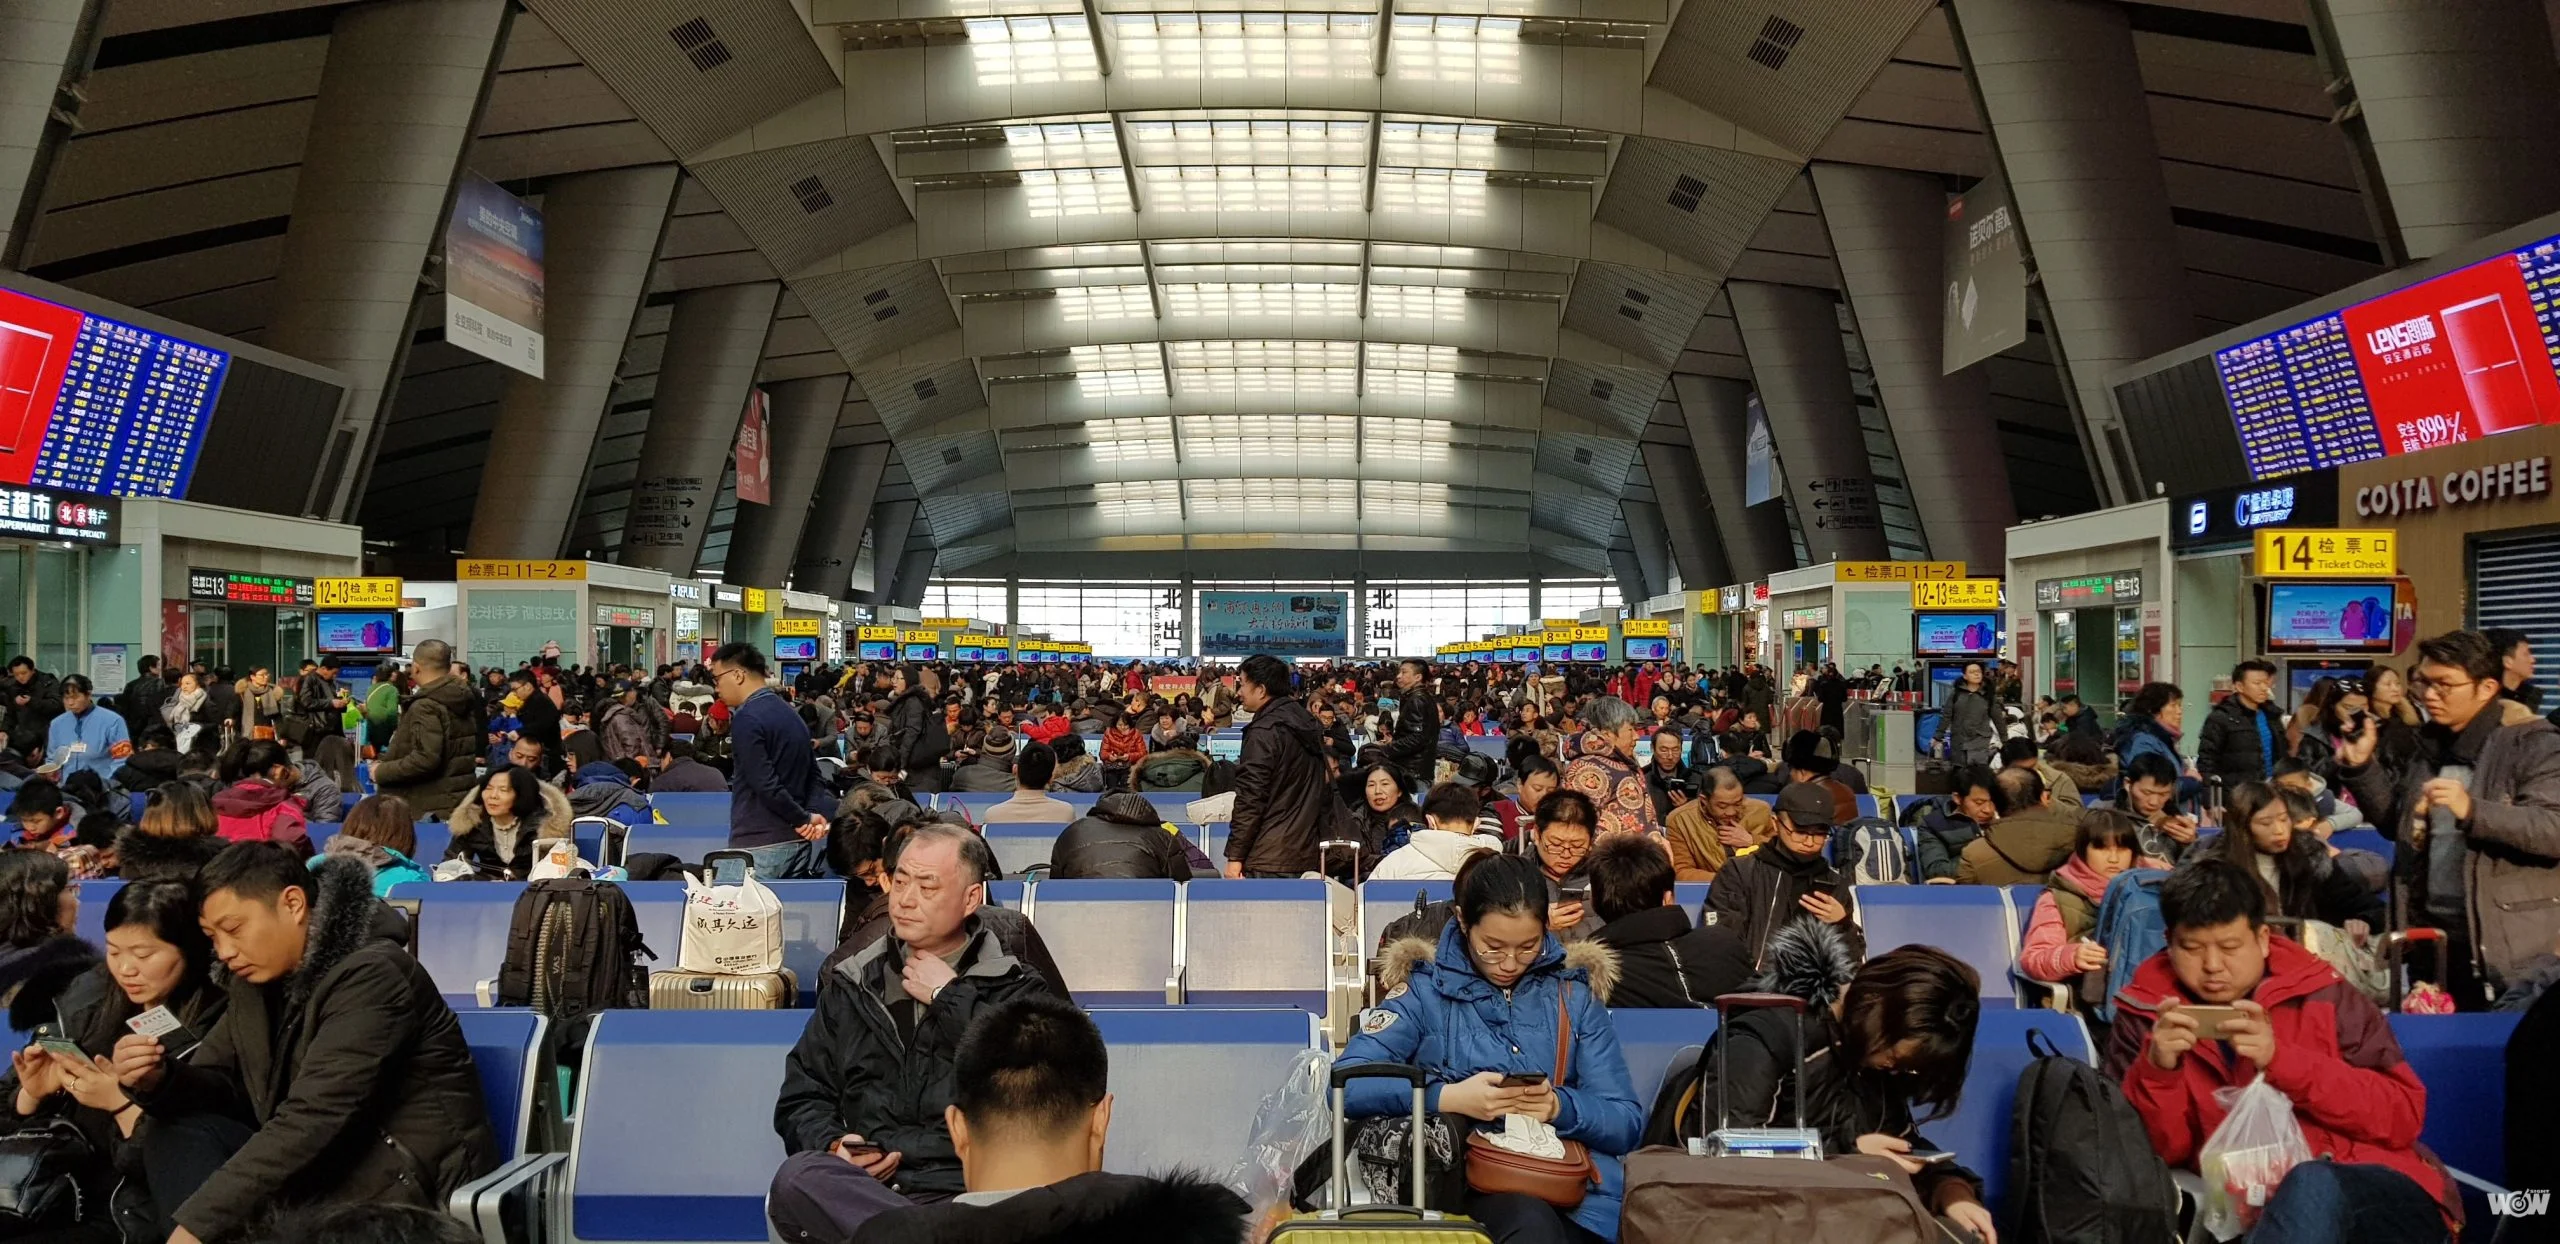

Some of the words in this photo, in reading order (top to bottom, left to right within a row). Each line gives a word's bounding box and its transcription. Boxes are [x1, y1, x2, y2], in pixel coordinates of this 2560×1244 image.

[2355, 476, 2434, 516] COSTA
[2442, 456, 2549, 504] COFFEE
[60, 505, 108, 526] 北京特产
[2273, 536, 2314, 571] 14
[2319, 537, 2387, 554] 检票口
[467, 563, 509, 577] 检票口
[2318, 559, 2351, 569] Ticket
[2353, 559, 2388, 569] Check
[1864, 564, 1907, 579] 检票口
[213, 576, 225, 596] 13
[319, 580, 349, 604] 12-13
[350, 582, 394, 593] 检票口
[2130, 576, 2140, 597] 13
[350, 595, 372, 603] Ticket
[372, 595, 394, 603] Check
[1917, 582, 1947, 606] 12-13
[1949, 584, 1993, 595] 检票口
[776, 621, 792, 633] 10-11
[1372, 588, 1394, 657] 北出口
[1626, 621, 1642, 634] 10-11
[864, 627, 872, 639] 9
[909, 631, 916, 642] 8
[1547, 632, 1554, 642] 8
[1575, 628, 1583, 640] 9
[958, 636, 964, 644] 7
[985, 638, 991, 646] 6
[1020, 641, 1026, 649] 5
[1474, 642, 1479, 650] 5
[1496, 639, 1502, 647] 6
[1515, 636, 1521, 645] 7
